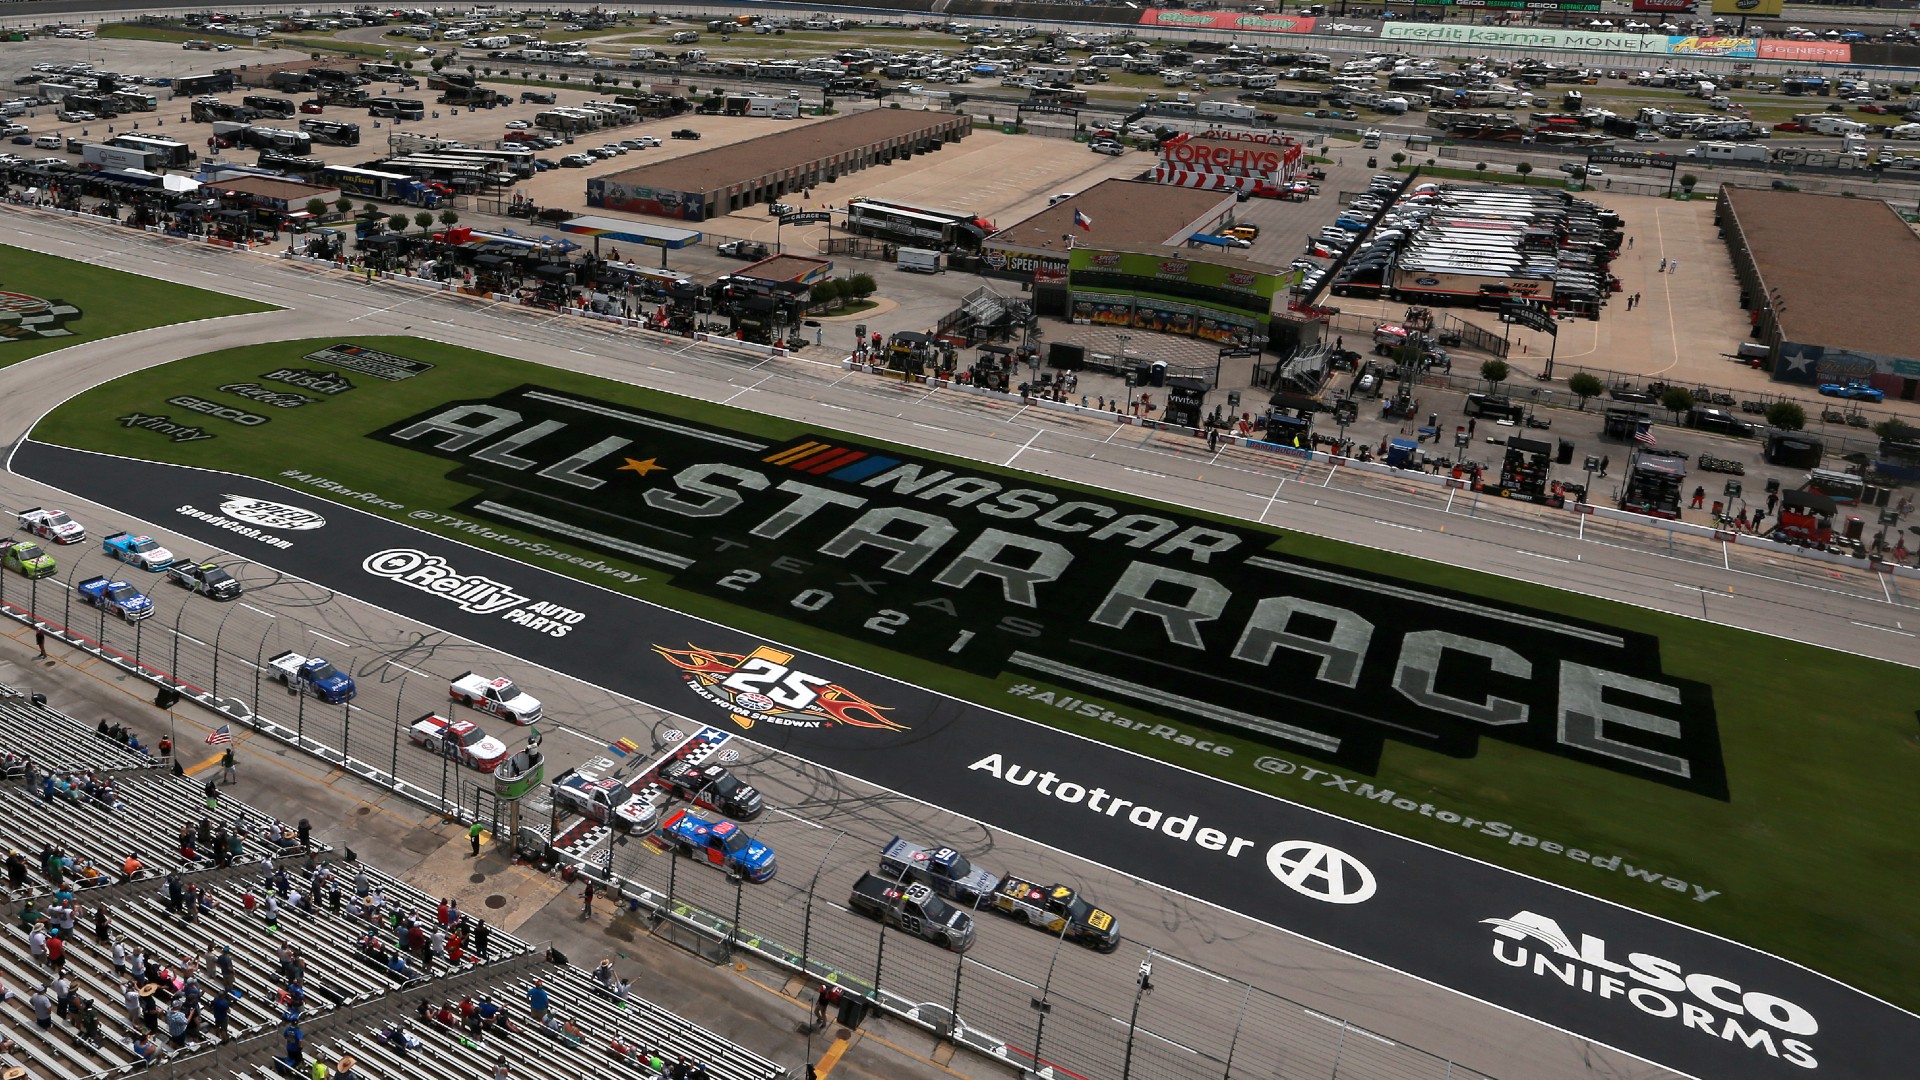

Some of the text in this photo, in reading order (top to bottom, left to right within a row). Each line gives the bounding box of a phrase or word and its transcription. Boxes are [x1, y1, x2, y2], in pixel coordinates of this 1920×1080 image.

[1389, 27, 1655, 50] credit karma MONEY
[1164, 143, 1279, 171] TORCHYS
[1612, 156, 1651, 165] GARAGE
[660, 327, 683, 336] Safelite
[1521, 309, 1545, 326] GARAGE
[267, 368, 348, 394] BUSCH
[169, 396, 265, 426] GEICO
[1250, 442, 1309, 459] BAMA BUGGIES
[235, 509, 304, 530] CASH
[244, 501, 322, 524] SPEEDY
[278, 469, 648, 585] #AllStarRace @TXMotorSpeedway
[860, 465, 1243, 563] NASCAR
[364, 549, 526, 614] O'Reilly
[390, 404, 1691, 778] ALL STAR RACE
[712, 536, 1045, 639] TEXAS
[502, 607, 574, 639] PARTS
[526, 600, 586, 625] AUTO
[716, 568, 976, 654] 2021
[722, 657, 832, 710] 25
[484, 699, 498, 713] 30
[686, 679, 821, 729] TEXAS MOTOR SPEEDWAY
[700, 790, 713, 804] 18
[967, 753, 1255, 859] Autotrader
[1007, 683, 1721, 903] #AllStarRace @TXMotorSpeedway
[936, 848, 956, 860] 16
[901, 914, 921, 934] 99
[1478, 910, 1818, 1036] ALSCO
[1492, 939, 1818, 1069] UNIFORMS
